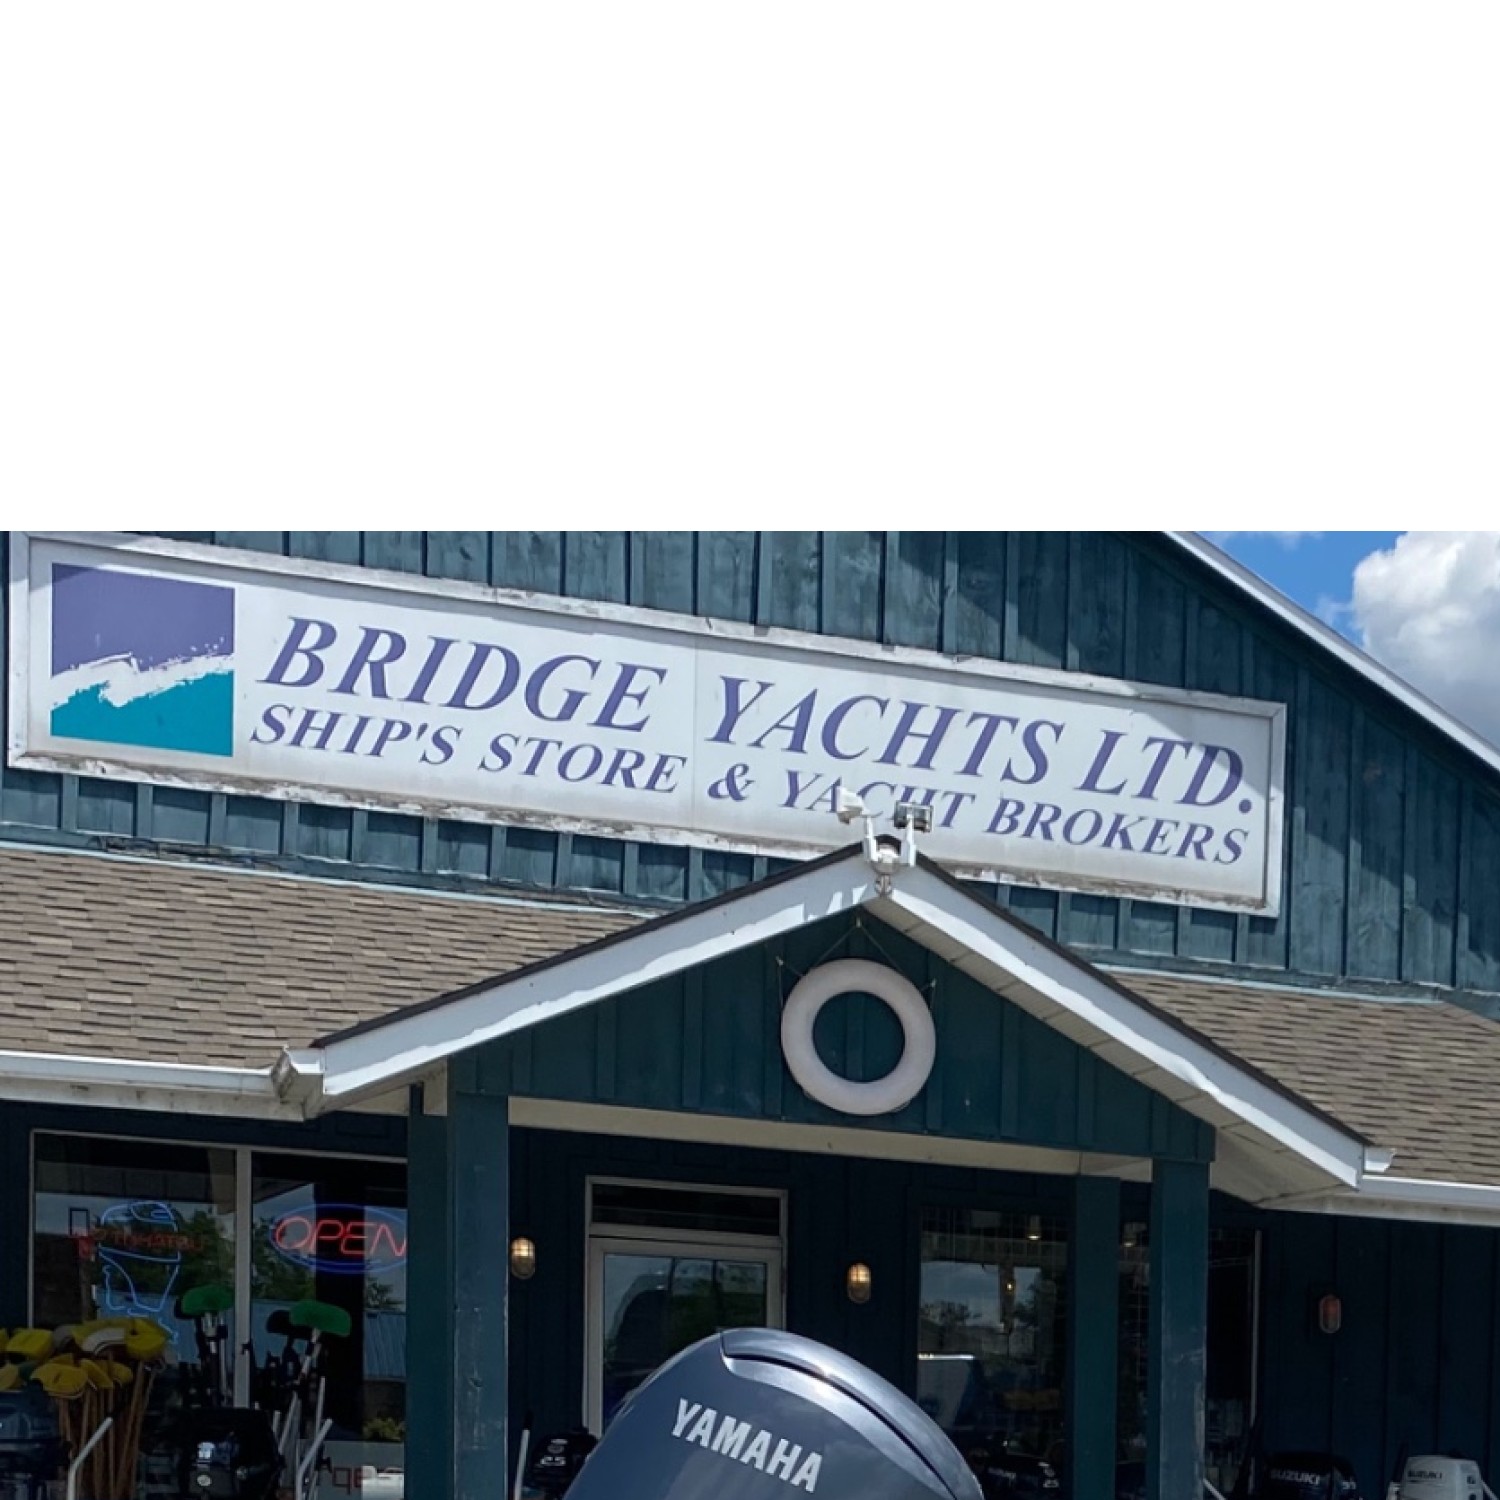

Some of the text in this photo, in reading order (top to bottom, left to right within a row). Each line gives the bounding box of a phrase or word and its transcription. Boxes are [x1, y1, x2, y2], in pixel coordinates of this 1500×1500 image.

[256, 616, 1253, 814] BRIDGE YACHTS LTD.
[250, 704, 1250, 865] SHIP'S STORE & YACHT BROKERS
[275, 1216, 406, 1256] OPEN
[672, 1397, 822, 1493] YAMAHA
